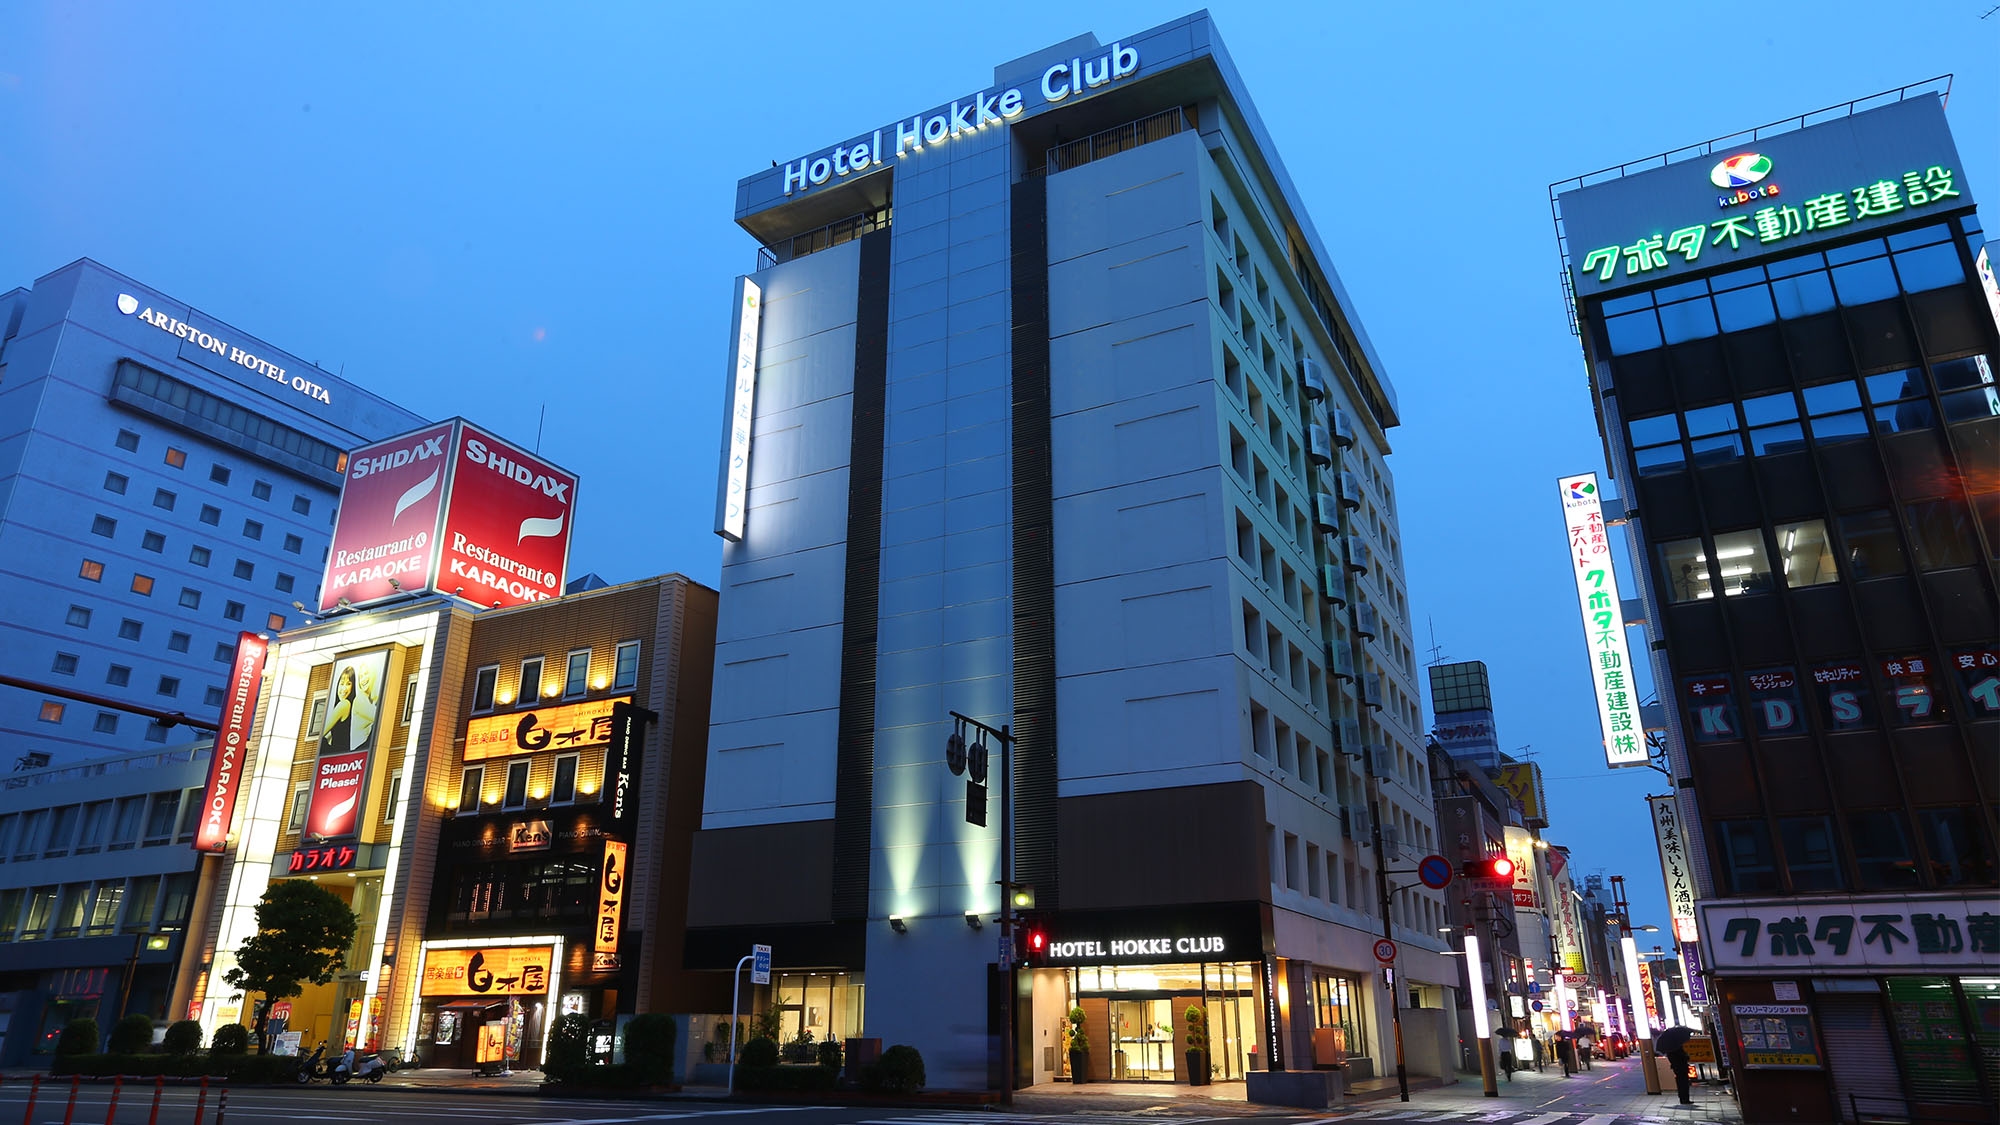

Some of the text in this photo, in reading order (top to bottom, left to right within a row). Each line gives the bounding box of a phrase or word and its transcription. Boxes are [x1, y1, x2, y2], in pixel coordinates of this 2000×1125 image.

[783, 42, 1141, 197] Hotel Hokke Club
[1718, 183, 1779, 209] kubota
[1582, 164, 1961, 281] クボタ不動産建設
[137, 307, 331, 405] ARISTON HOTEL OITA
[351, 434, 447, 479] SHIDAX
[465, 439, 569, 504] SHIDAX
[334, 534, 414, 569] Restaurant
[1571, 525, 1590, 568] デパート
[1587, 512, 1607, 554] 不動産の
[333, 555, 423, 589] KARAOKE
[451, 531, 544, 584] Restaurant
[449, 558, 551, 603] KARAOKE
[1887, 660, 1926, 676] 快適
[1957, 652, 1999, 669] 安心
[229, 643, 262, 730] Restaurant
[1692, 682, 1725, 695] キー
[1754, 679, 1794, 690] マンション
[320, 774, 359, 789] Please!
[321, 759, 364, 775] SHIDAX
[206, 745, 236, 836] KARAOKE
[614, 772, 630, 819] Ken's
[513, 828, 551, 844] Ken's
[288, 846, 356, 871] カラオケ
[1659, 802, 1693, 917] 九州美味いもん酒場
[600, 852, 622, 943] 白木屋
[1050, 936, 1225, 958] HOTEL HOKKE CLUB
[1379, 945, 1392, 956] 30
[467, 952, 545, 993] 白木屋
